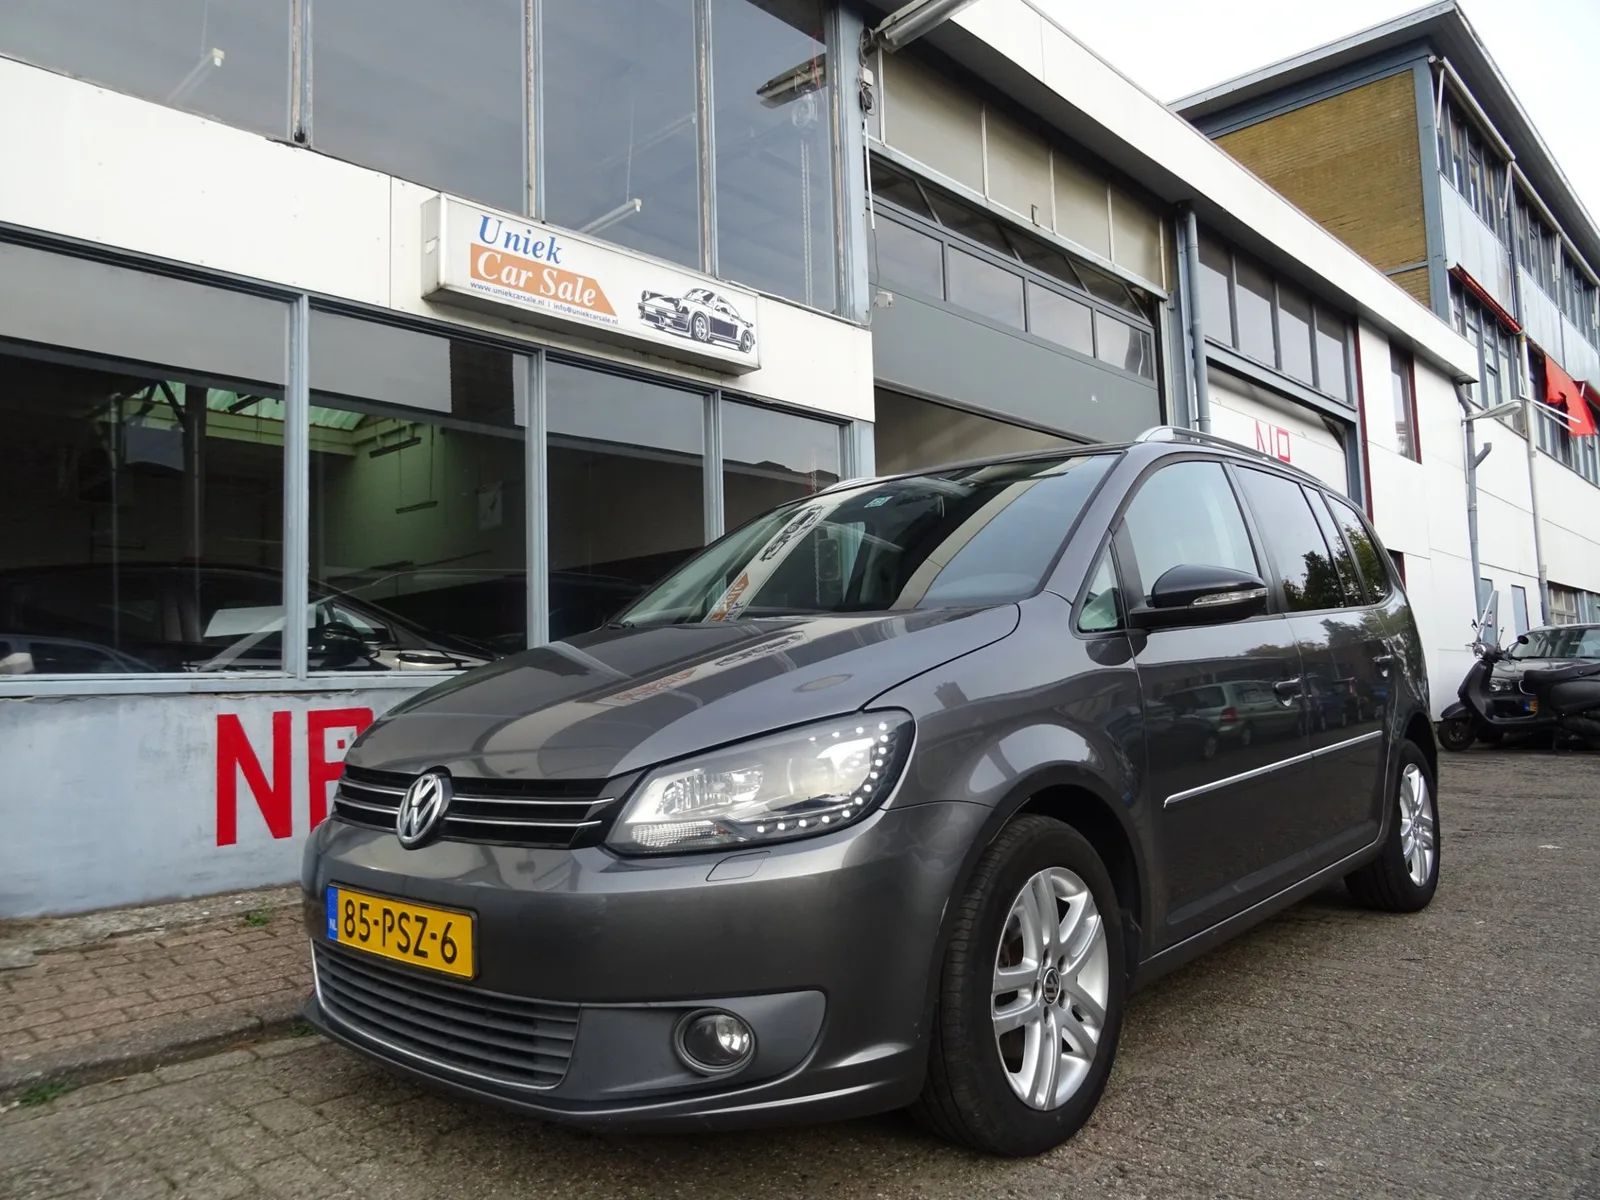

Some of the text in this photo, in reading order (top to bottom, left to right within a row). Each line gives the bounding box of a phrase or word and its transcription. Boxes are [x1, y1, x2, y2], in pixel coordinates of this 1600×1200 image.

[479, 214, 562, 264] Uniek
[470, 281, 619, 325] www.uniekcarsale.nl info@uniekcarsale.nl
[477, 250, 596, 306] Car Sale
[344, 898, 458, 965] 85-PSZ-6
